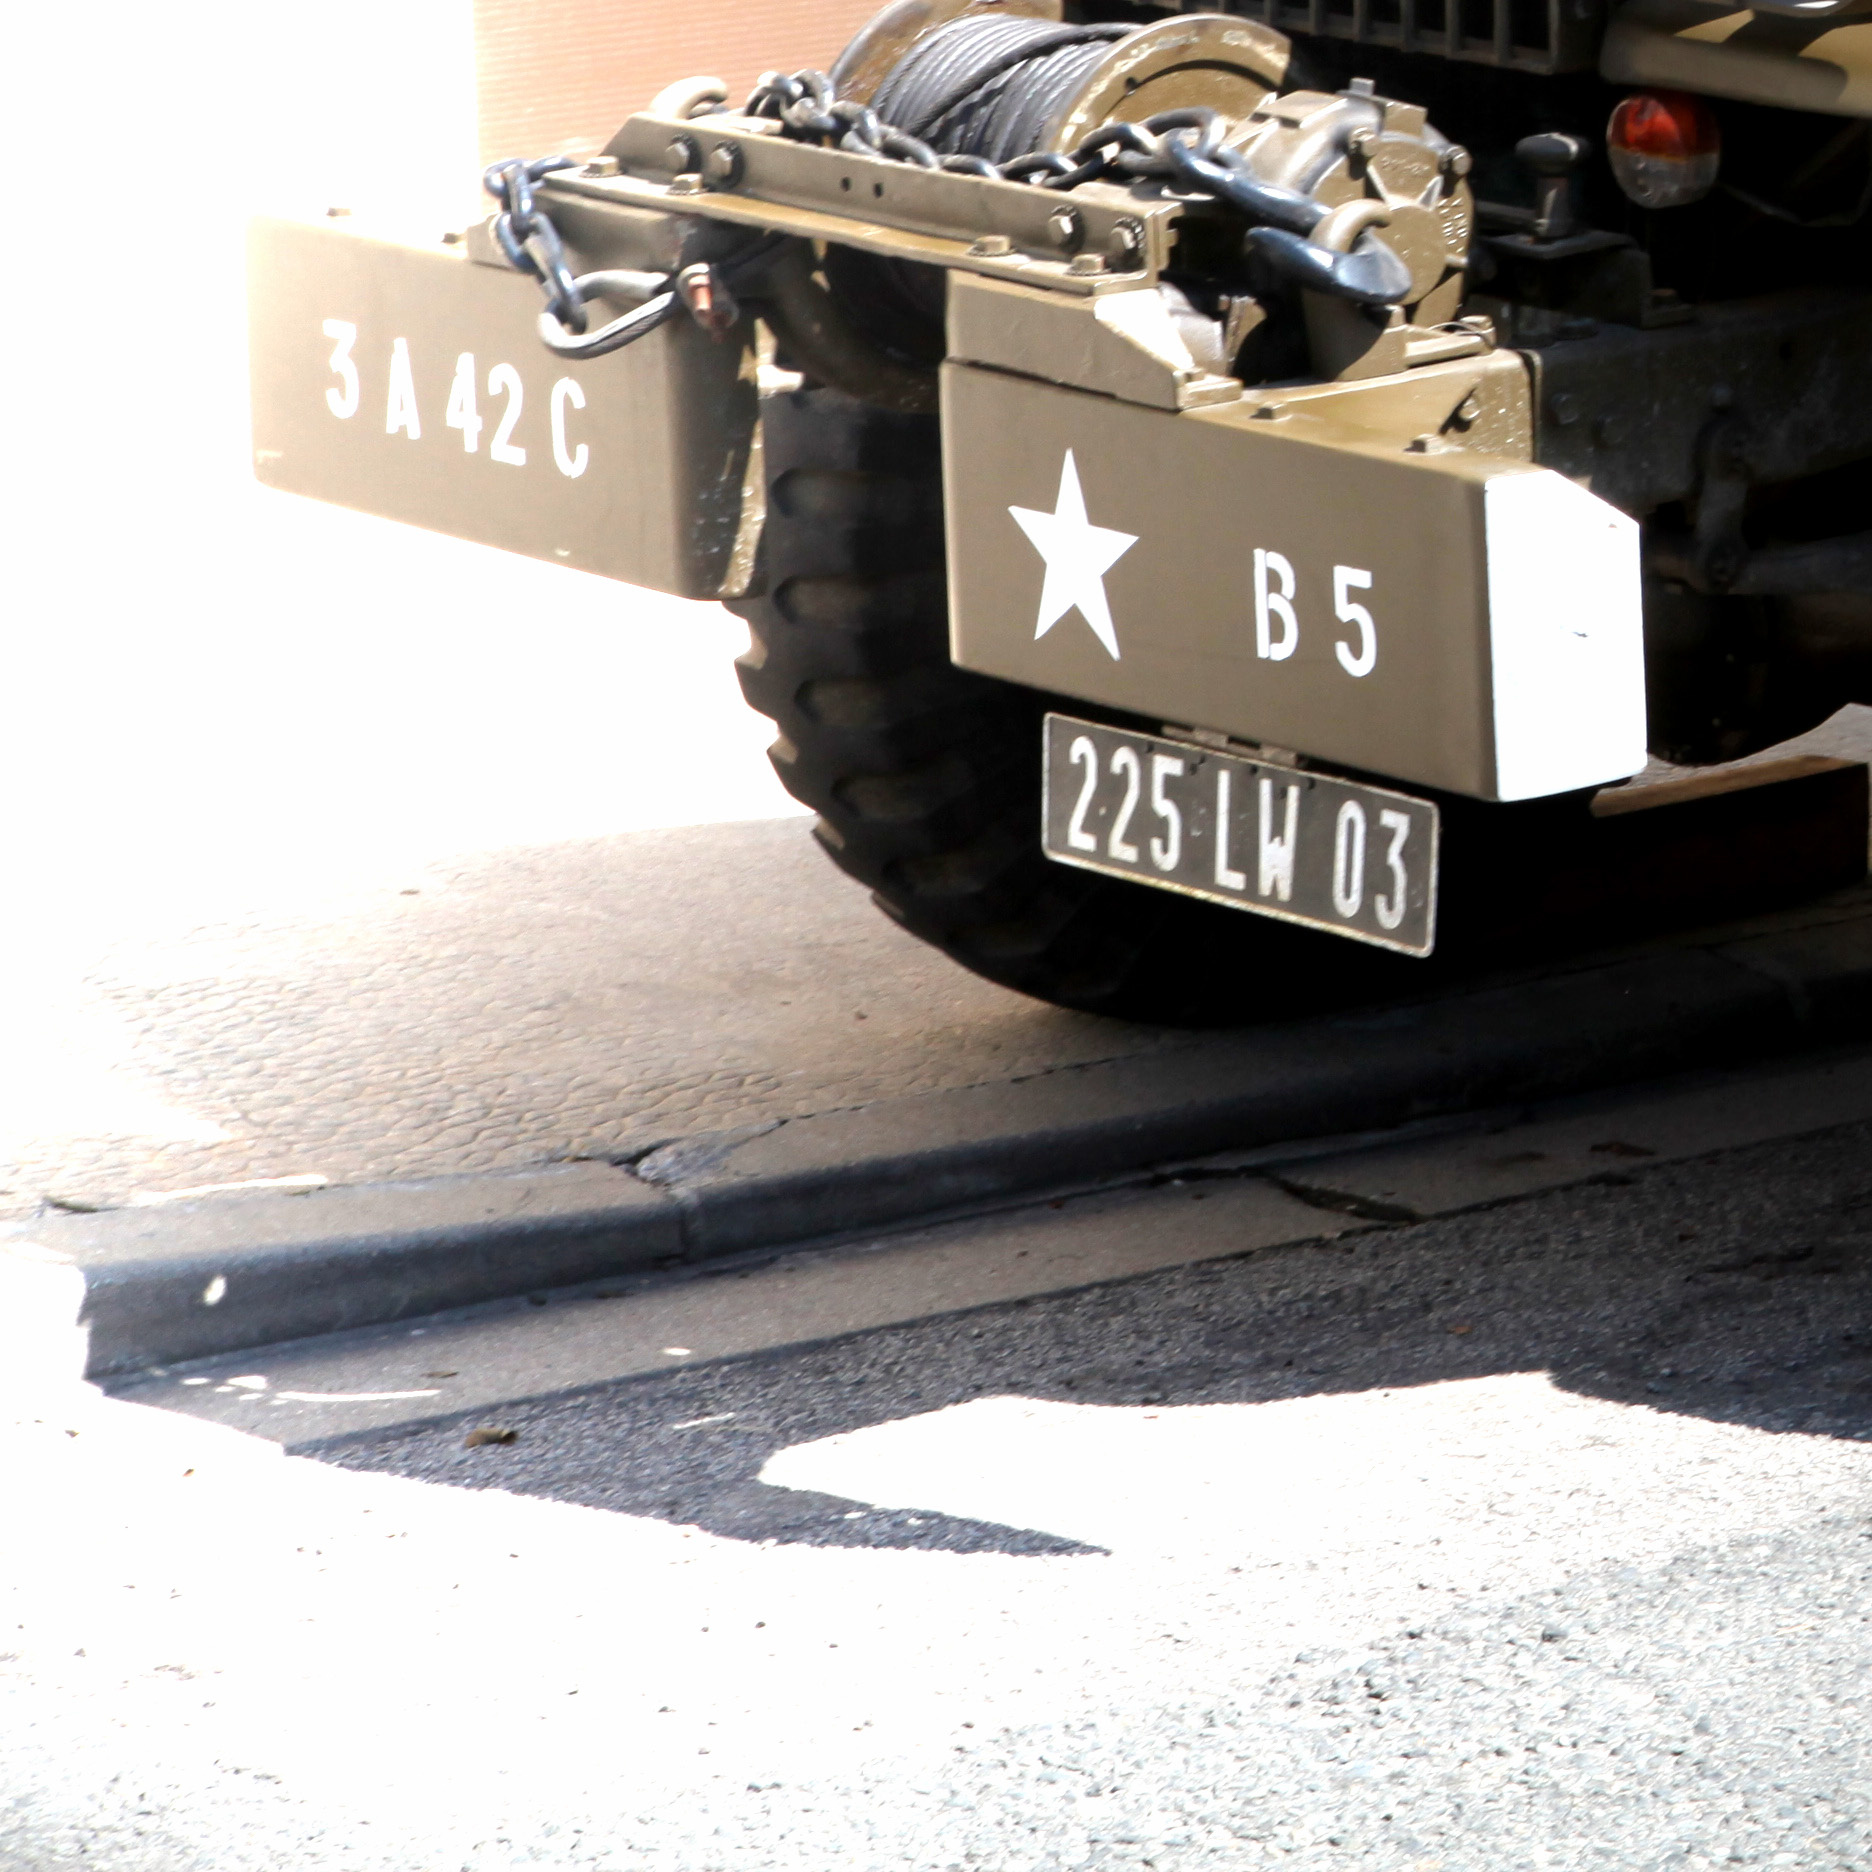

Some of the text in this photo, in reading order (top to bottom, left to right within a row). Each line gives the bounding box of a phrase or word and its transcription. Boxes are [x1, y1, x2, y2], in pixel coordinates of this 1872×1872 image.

[321, 318, 589, 480] 3 A 42 C
[1253, 548, 1377, 679] B 5
[1067, 734, 1411, 931] 225 LW 03
